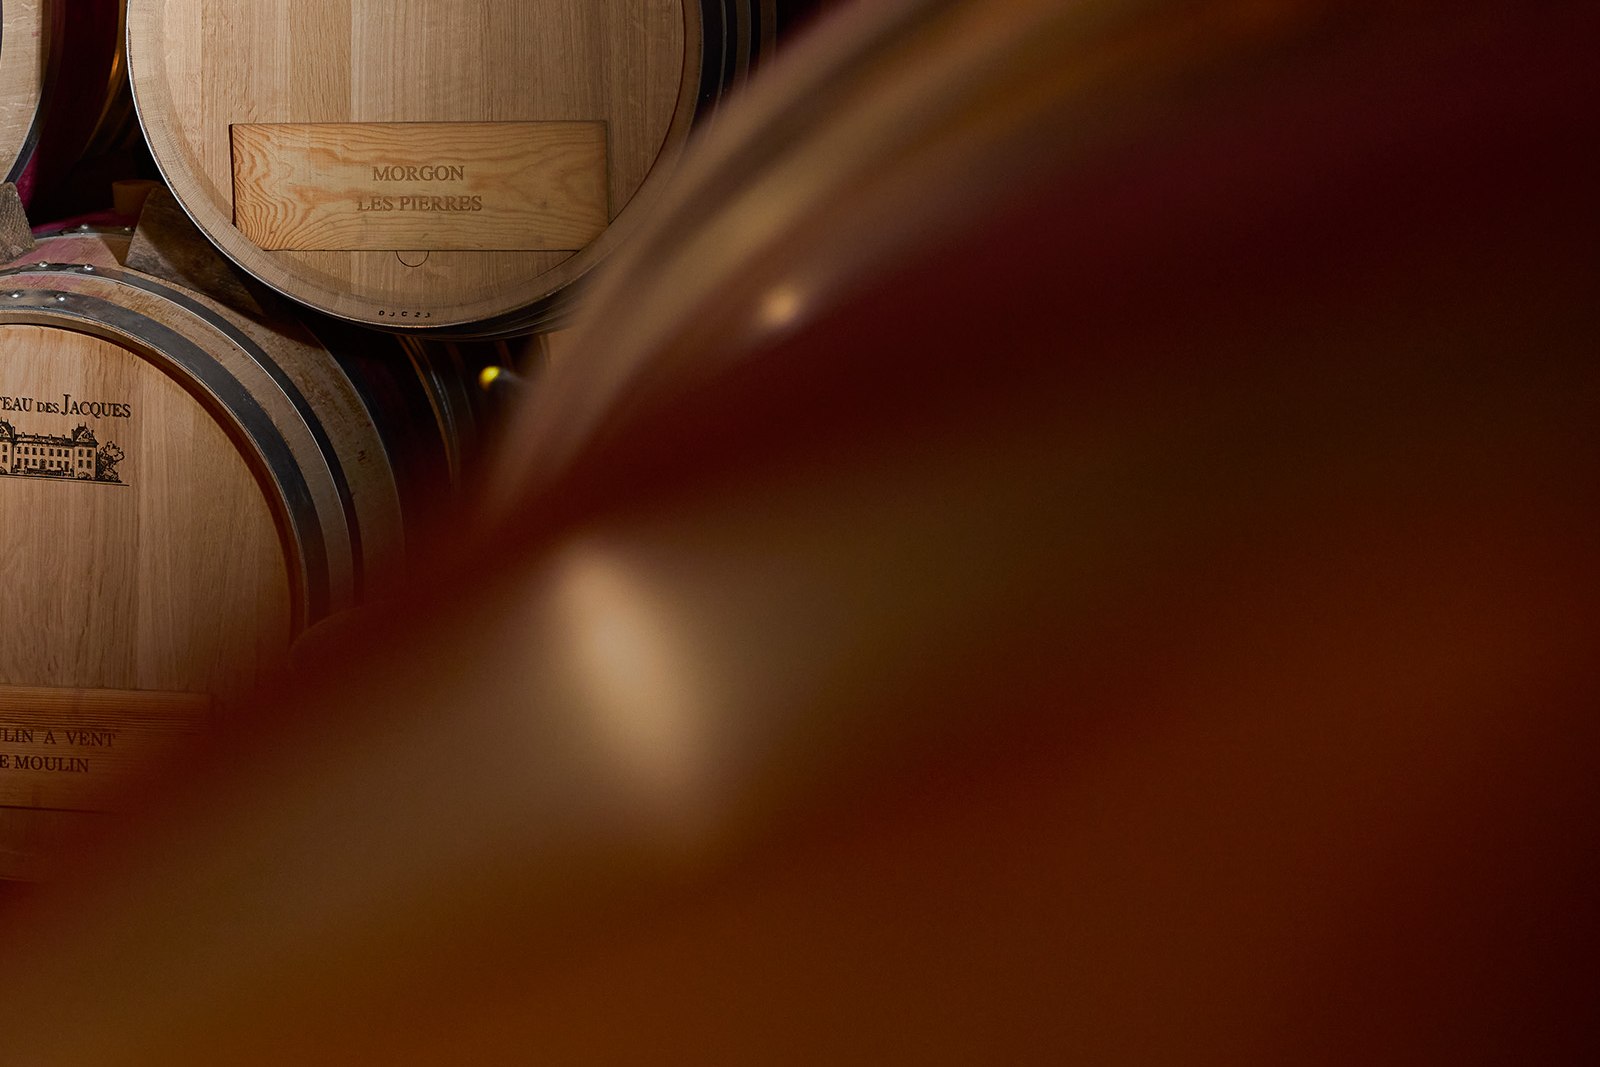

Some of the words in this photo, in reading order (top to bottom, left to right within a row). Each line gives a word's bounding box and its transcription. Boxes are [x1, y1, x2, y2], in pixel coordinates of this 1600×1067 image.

[371, 165, 465, 182] MORGON
[357, 195, 394, 212] LES
[398, 195, 483, 213] PIERRES
[36, 401, 60, 414] DES
[60, 393, 132, 419] JACQUES
[43, 730, 56, 745] A
[65, 730, 116, 748] VENT
[13, 754, 90, 773] MOULIN
